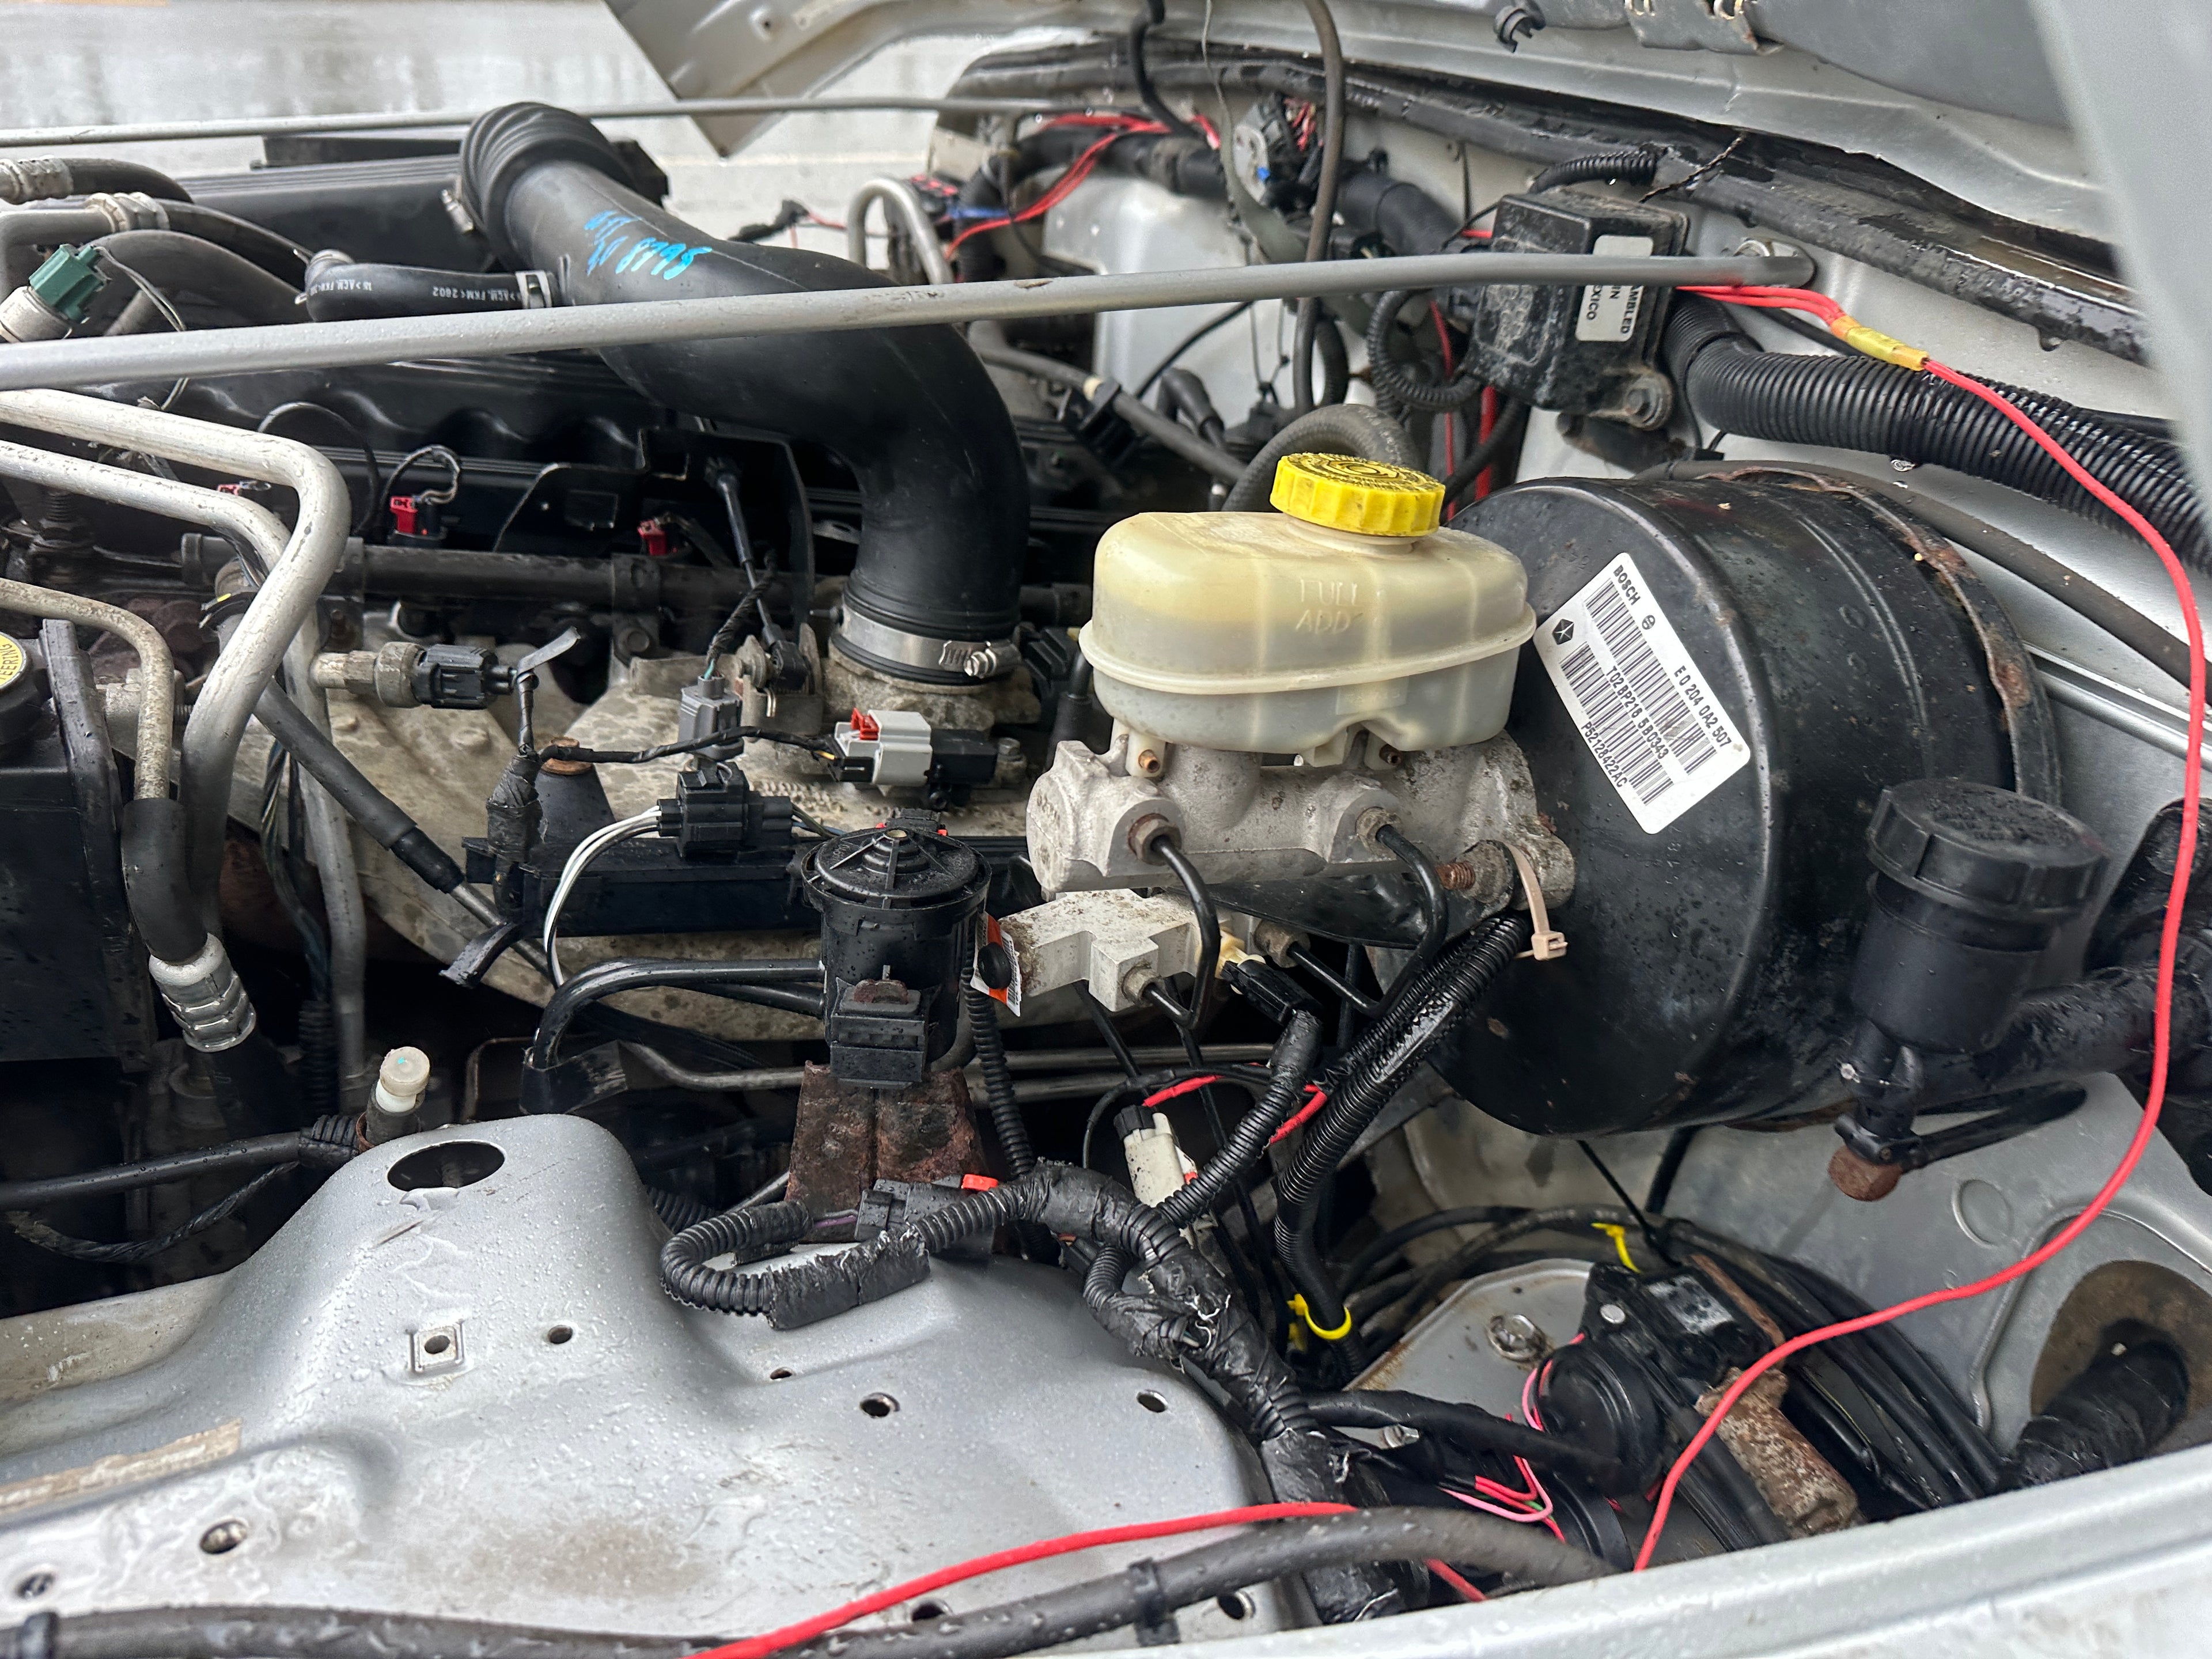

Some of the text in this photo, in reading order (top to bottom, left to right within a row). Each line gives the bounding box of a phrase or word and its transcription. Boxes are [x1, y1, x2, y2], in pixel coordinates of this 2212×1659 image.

[1613, 565, 1641, 605] BOSCH
[1296, 609, 1351, 634] ADD
[1684, 684, 1704, 706] 204
[1712, 725, 1732, 747] 507
[1581, 721, 1627, 787] P52128422AC
